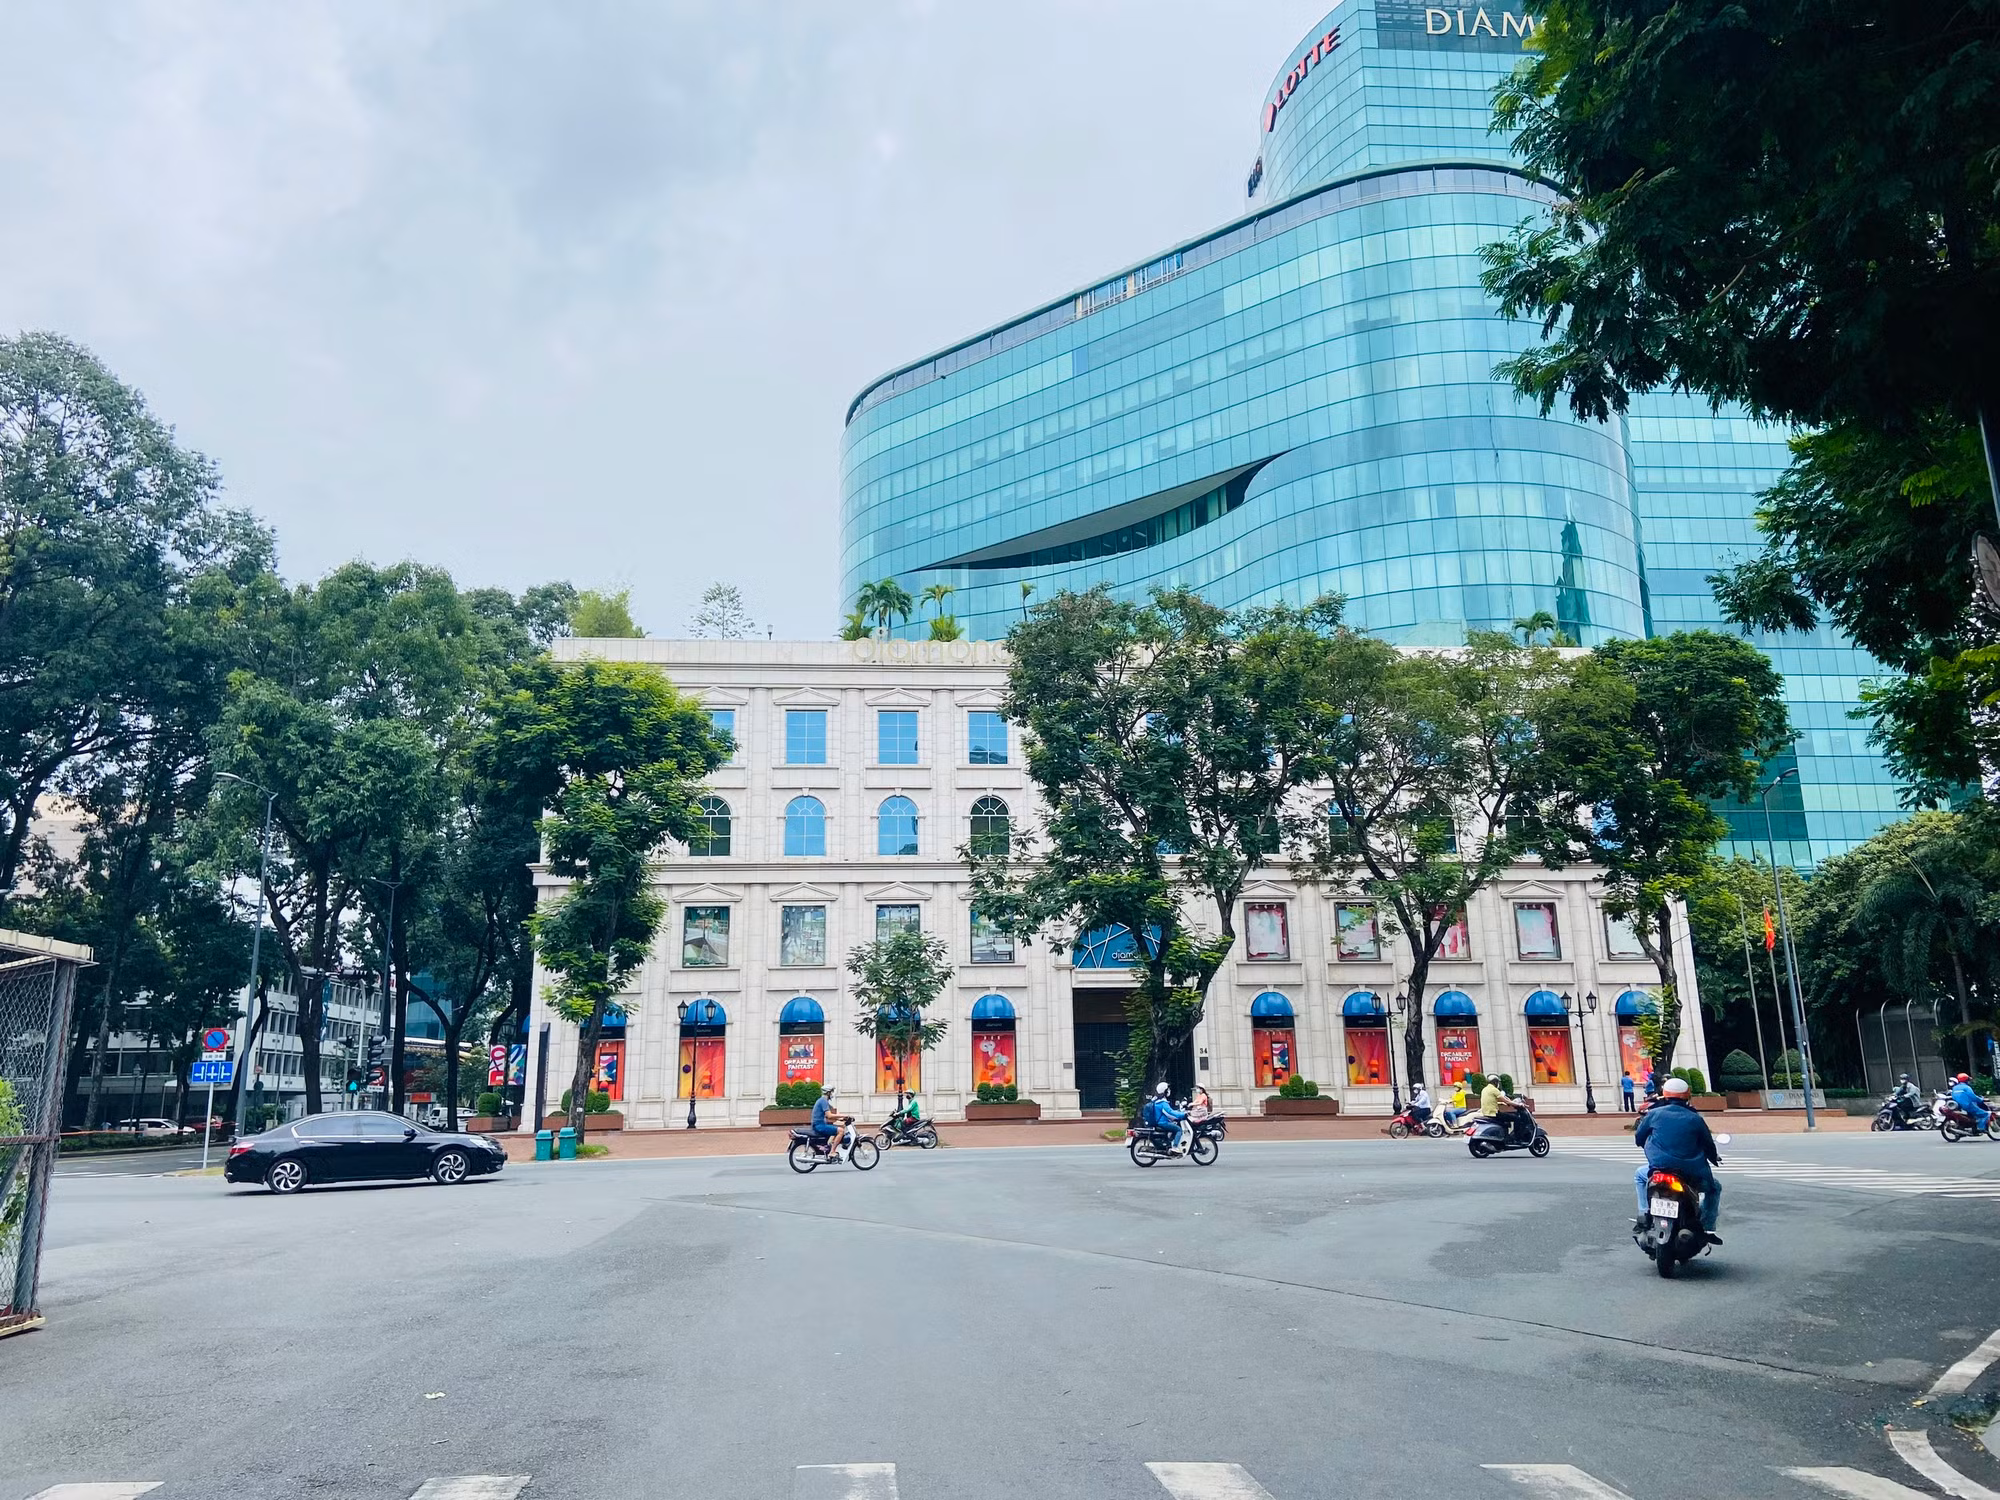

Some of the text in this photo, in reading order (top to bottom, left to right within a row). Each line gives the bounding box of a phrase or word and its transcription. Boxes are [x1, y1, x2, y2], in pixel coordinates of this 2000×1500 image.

[1425, 6, 1549, 37] DIAM
[1276, 25, 1341, 112] LOTTE
[1199, 1047, 1208, 1055] 34
